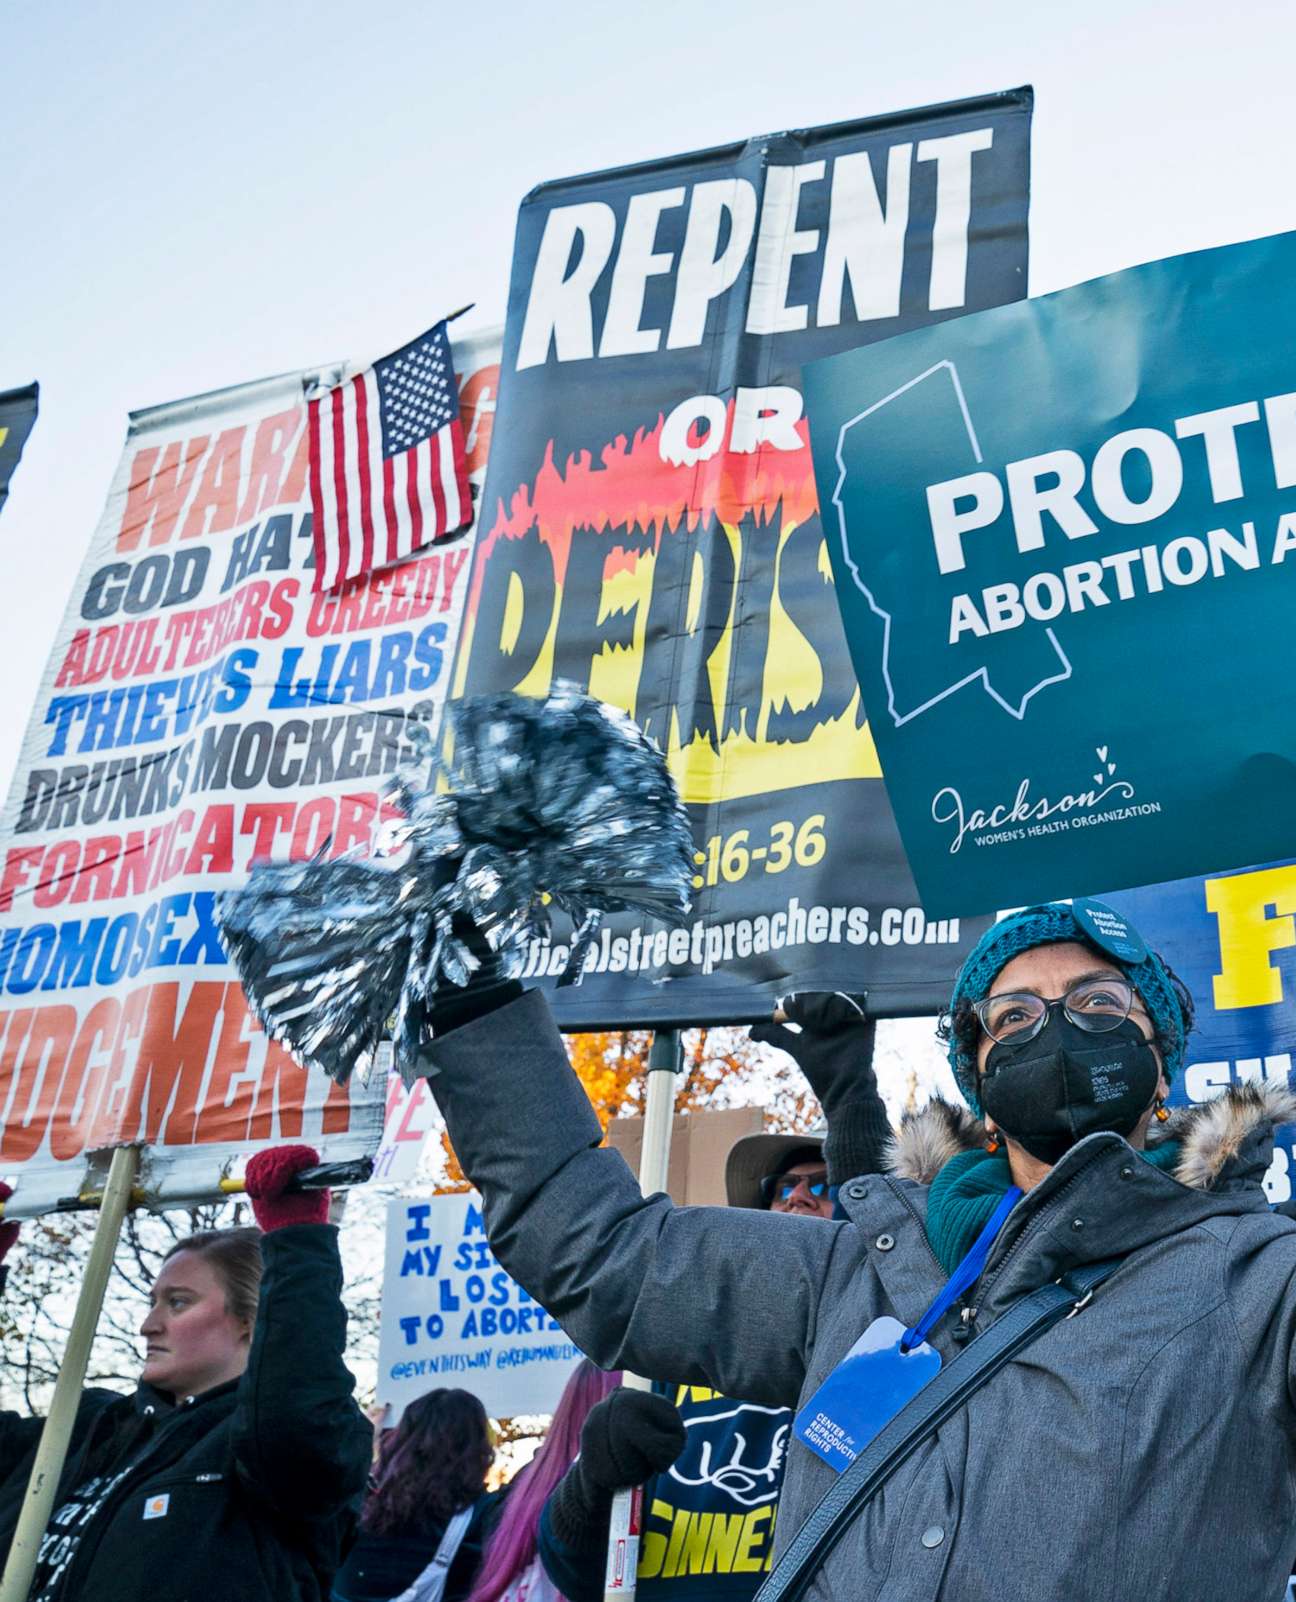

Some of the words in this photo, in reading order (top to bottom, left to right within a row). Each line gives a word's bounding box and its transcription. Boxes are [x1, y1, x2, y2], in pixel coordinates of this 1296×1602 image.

[516, 128, 993, 372] REPENT
[659, 386, 805, 469] OR
[81, 547, 211, 621] GOD
[306, 548, 469, 638] GREEDY
[949, 521, 1260, 645] ABORTION
[268, 622, 449, 710] LIARS
[462, 503, 867, 760] PERIS
[14, 738, 196, 835] DRUNKS
[932, 779, 1134, 853] Jackson
[974, 829, 1026, 847] WOMEN'S
[1027, 821, 1070, 838] HEALTH
[1071, 801, 1161, 829] ORGANIZATION
[0, 792, 406, 913] FORNICATOR
[401, 1245, 442, 1277] MY
[407, 1205, 431, 1242] I
[400, 1313, 444, 1345] TO
[803, 1427, 832, 1454] RIGHTS
[816, 1412, 846, 1440] CENTER
